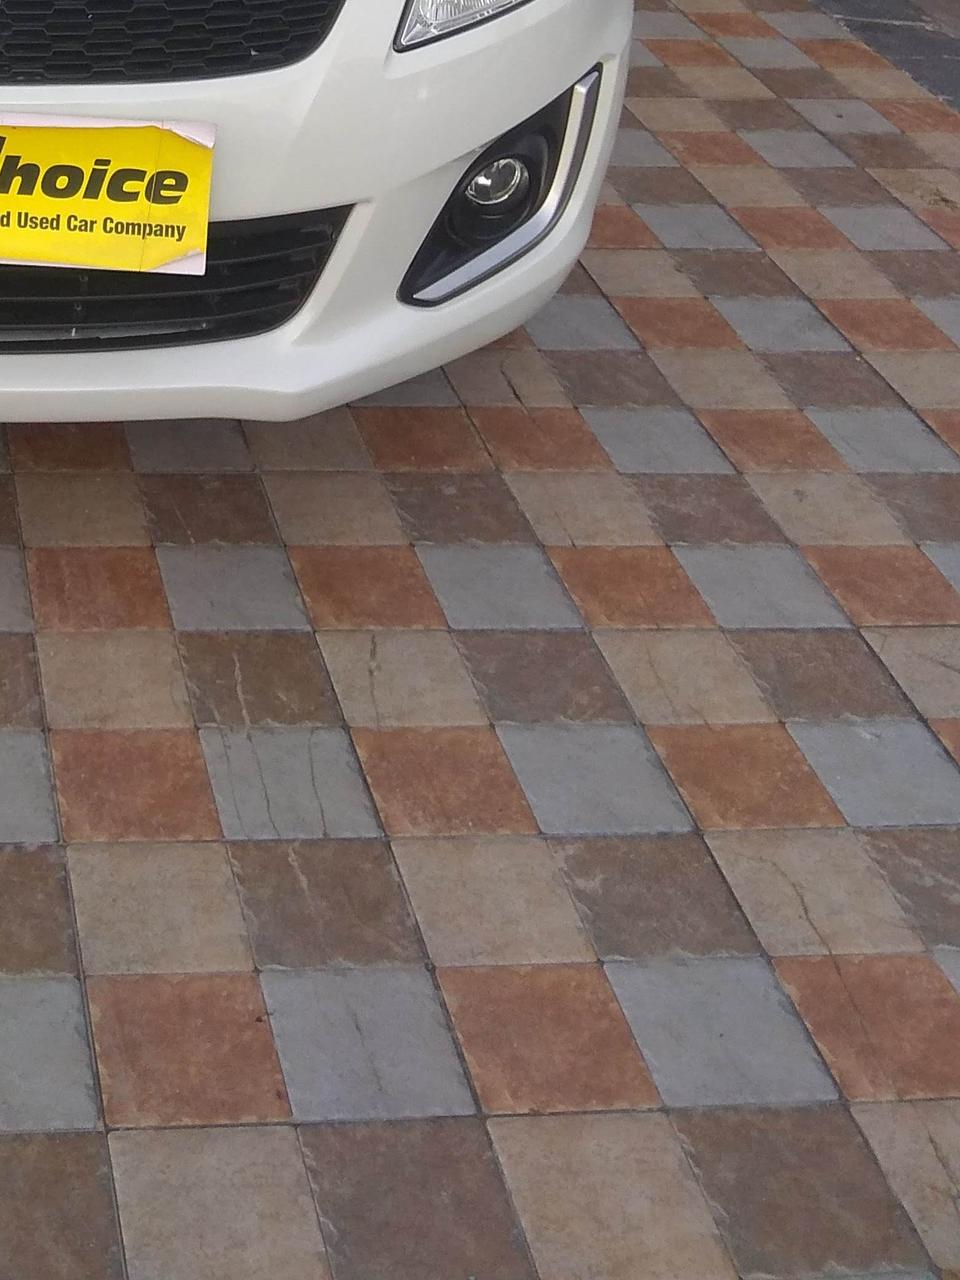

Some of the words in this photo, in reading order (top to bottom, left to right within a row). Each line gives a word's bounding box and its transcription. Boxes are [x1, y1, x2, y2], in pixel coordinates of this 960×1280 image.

[17, 211, 60, 231] Used
[66, 214, 97, 233] Car
[102, 216, 187, 241] Company
